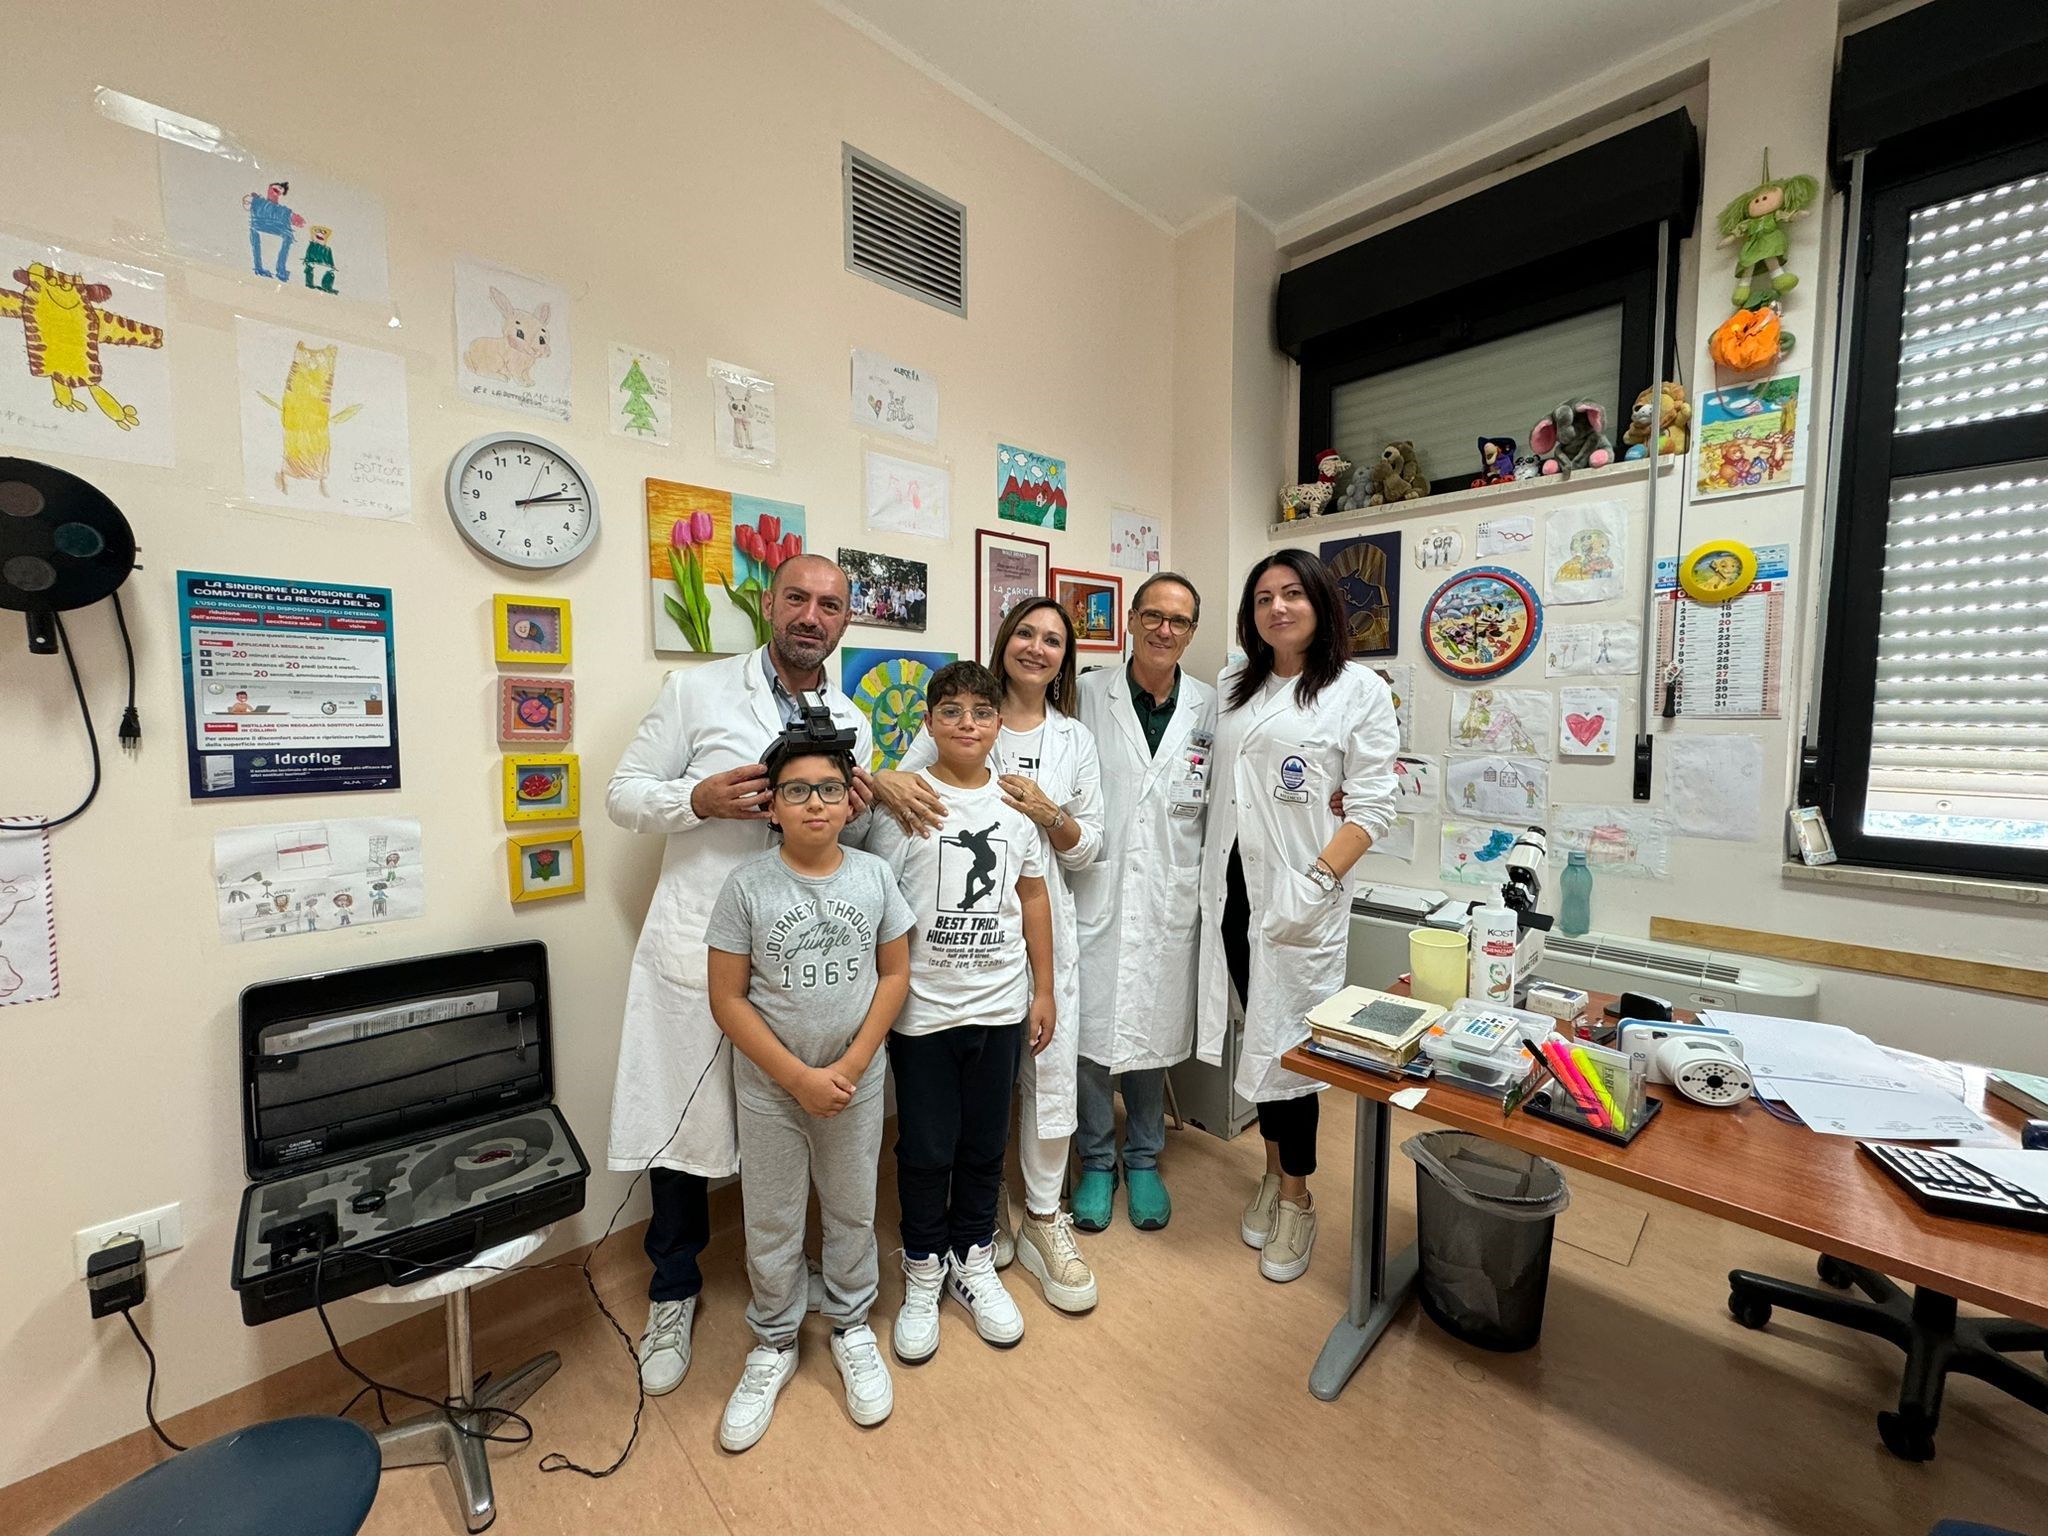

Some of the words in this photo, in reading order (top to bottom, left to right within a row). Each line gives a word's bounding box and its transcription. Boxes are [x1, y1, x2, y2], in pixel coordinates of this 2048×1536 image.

[494, 457, 507, 468] 11
[517, 455, 531, 466] 12
[477, 470, 493, 481] 10
[545, 466, 550, 475] 1
[561, 483, 568, 493] 2
[472, 489, 480, 499] 9
[568, 504, 576, 513] 3
[479, 511, 487, 521] 8
[563, 522, 570, 531] 4
[498, 529, 506, 538] 7
[524, 538, 532, 548] 6
[546, 536, 554, 545] 5
[204, 580, 222, 588] LA
[225, 582, 289, 594] SINDROME
[291, 587, 307, 595] DA
[310, 589, 354, 599] VISIONE
[993, 584, 1003, 594] LA
[1006, 586, 1034, 597] CARICA
[193, 588, 263, 600] COMPUTER
[276, 594, 292, 602] LA
[295, 595, 340, 605] REGOLA
[231, 650, 247, 659] 20
[285, 661, 300, 669] 20
[253, 670, 269, 678] 20
[275, 752, 342, 766] Idroflog
[935, 915, 968, 931] BEST
[970, 917, 999, 931] TRICK
[765, 899, 817, 963] JOURNEY
[826, 899, 873, 953] THROUGH
[810, 920, 839, 938] The
[1487, 928, 1514, 938] KOST
[925, 929, 978, 946] HIGHEST
[980, 930, 1006, 946] OLLIE
[784, 926, 851, 960] Jungle
[781, 956, 860, 989] 1965
